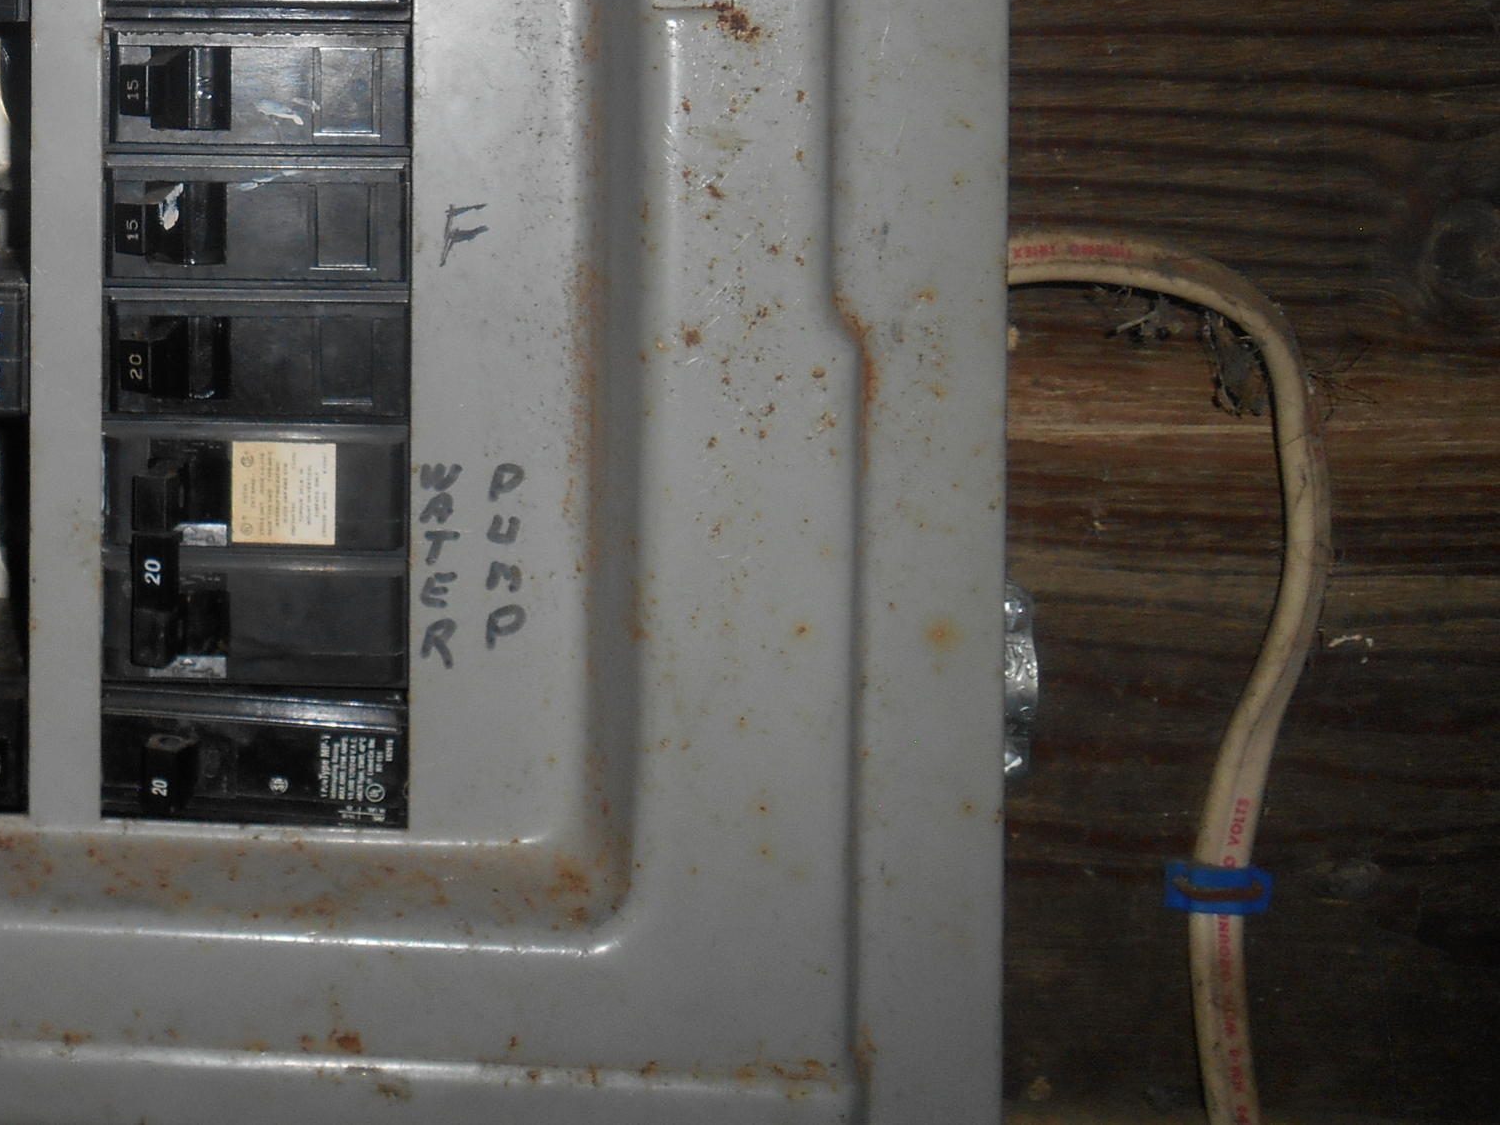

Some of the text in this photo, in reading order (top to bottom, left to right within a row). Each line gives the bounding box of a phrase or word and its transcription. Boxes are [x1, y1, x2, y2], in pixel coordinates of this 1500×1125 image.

[126, 79, 140, 101] 15
[126, 220, 140, 242] 15
[130, 352, 143, 380] 20
[419, 462, 464, 670] WATER
[486, 461, 527, 652] PUMP
[144, 557, 162, 586] 20
[319, 759, 331, 780] Type
[151, 778, 168, 797] 20
[1227, 797, 1251, 847] VOLTS
